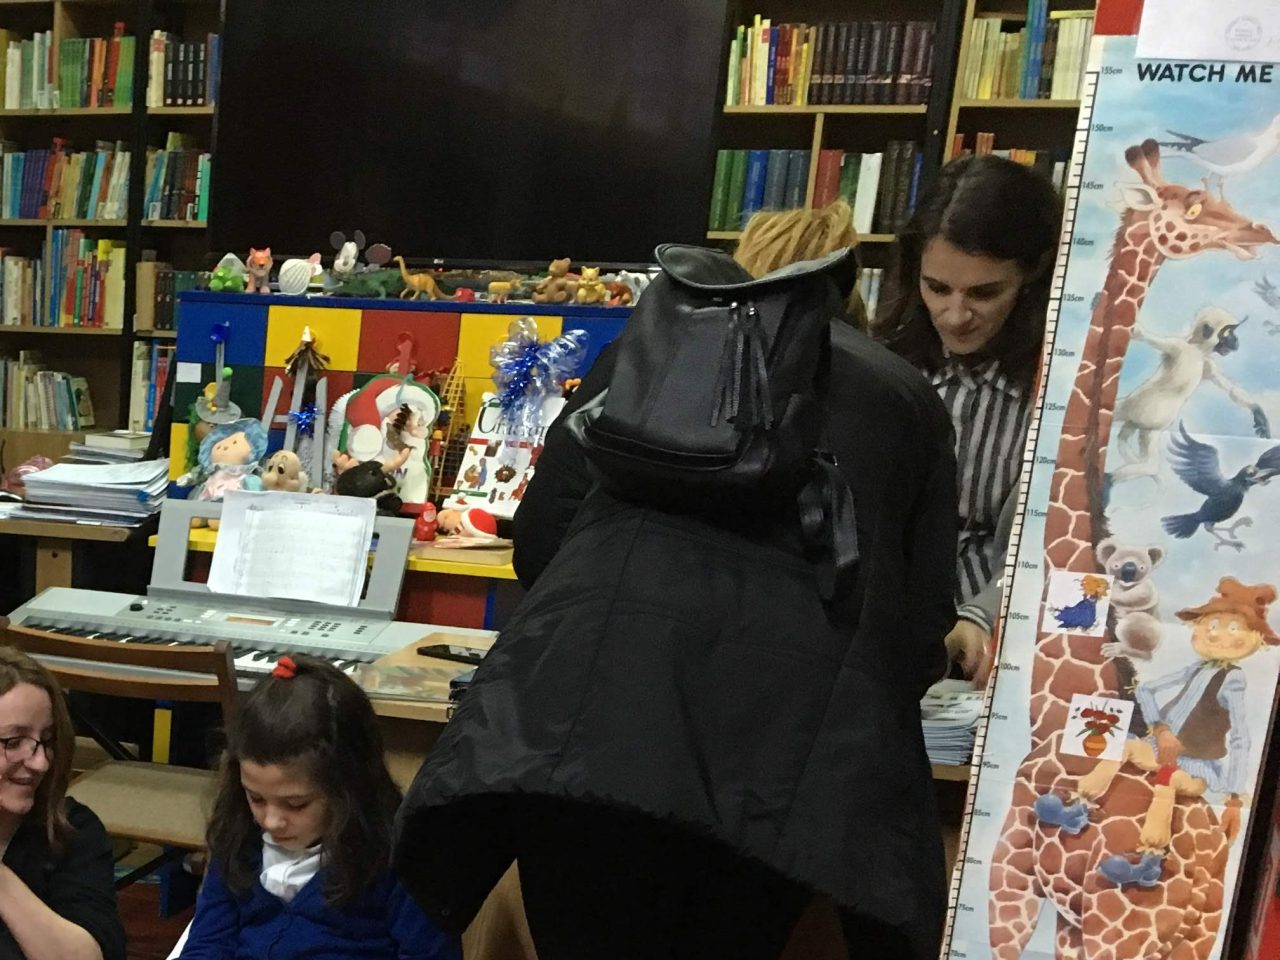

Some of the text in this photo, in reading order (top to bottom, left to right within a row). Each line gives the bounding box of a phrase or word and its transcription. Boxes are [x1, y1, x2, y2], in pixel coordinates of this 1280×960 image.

[1137, 63, 1274, 83] WATCH ME
[1036, 456, 1056, 464] 120cm
[1017, 561, 1038, 569] 110cm
[1008, 612, 1029, 620] 105cm
[991, 712, 1008, 720] 95cm
